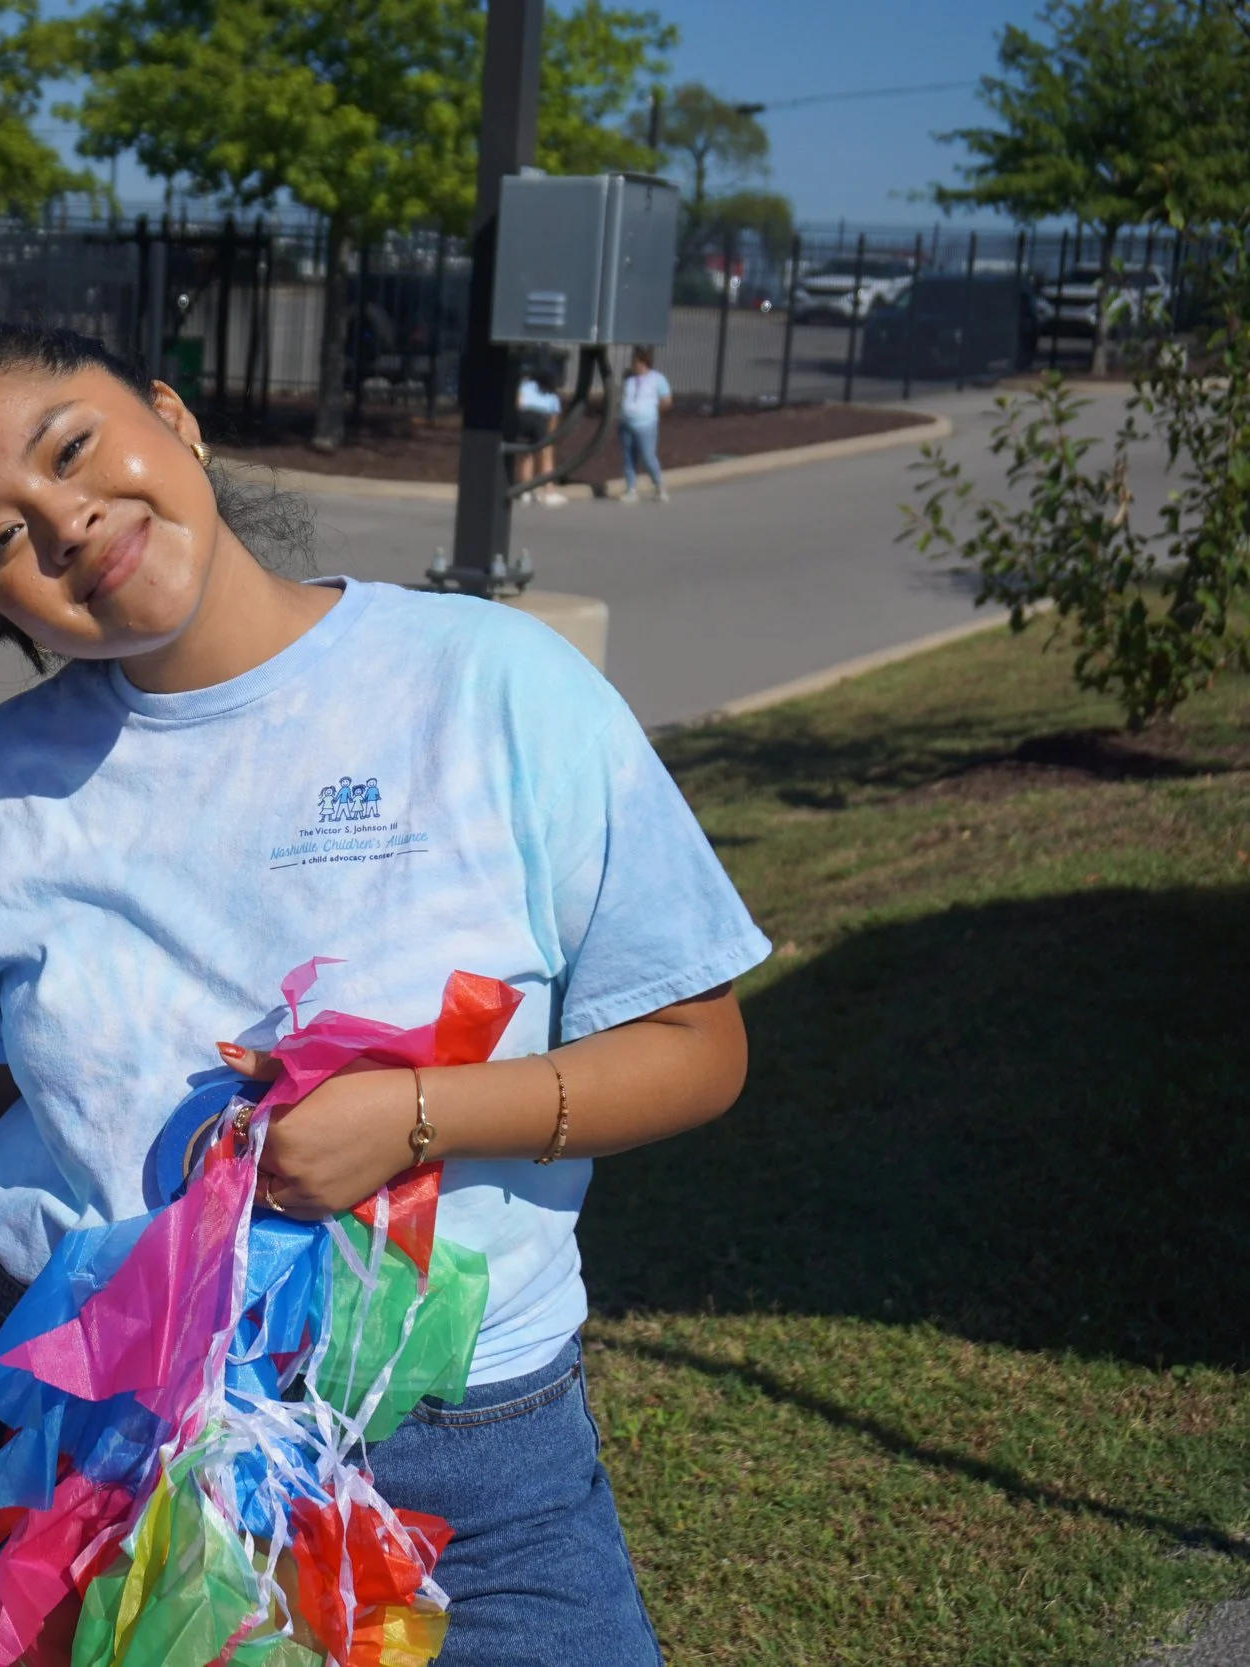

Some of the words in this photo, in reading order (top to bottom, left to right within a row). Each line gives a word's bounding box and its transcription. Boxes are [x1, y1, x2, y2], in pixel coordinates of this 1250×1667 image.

[299, 829, 314, 837] The
[315, 826, 342, 835] Victor
[344, 825, 352, 834] S.
[353, 824, 388, 835] Johnson
[390, 822, 398, 831] III
[270, 842, 318, 860] Nashville
[323, 838, 381, 852] Children's
[385, 832, 429, 849] Alliance
[308, 855, 327, 864] child
[329, 854, 366, 862] advocacy
[369, 852, 394, 860] center
